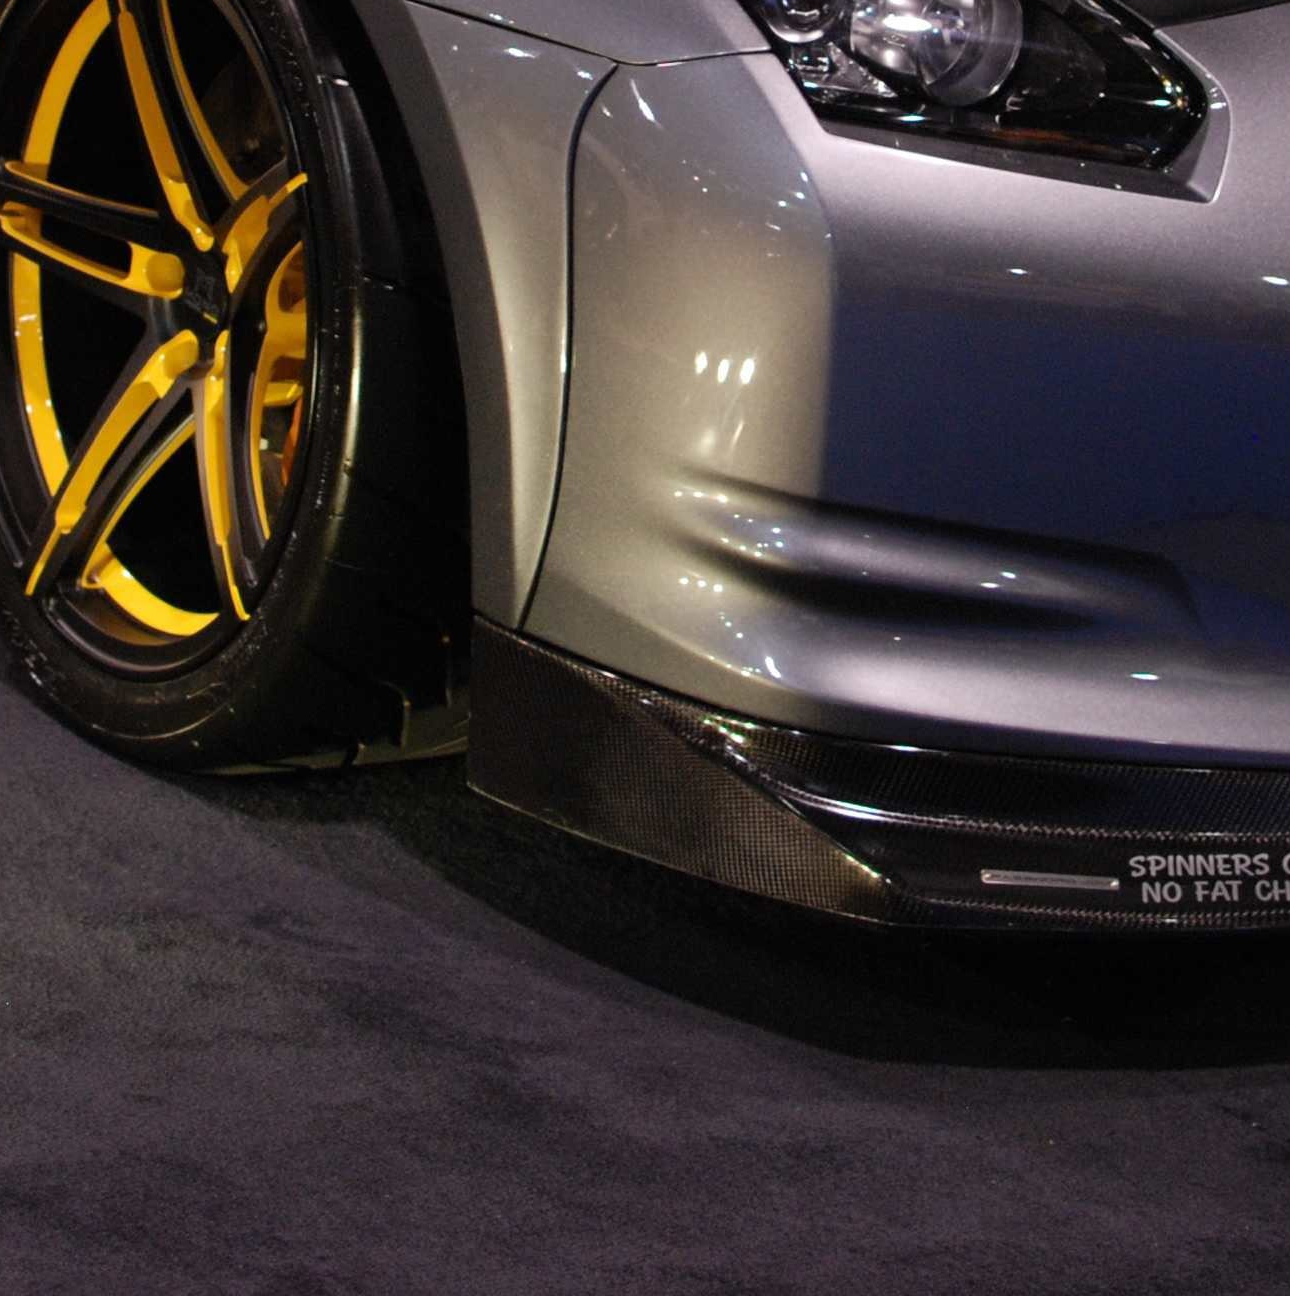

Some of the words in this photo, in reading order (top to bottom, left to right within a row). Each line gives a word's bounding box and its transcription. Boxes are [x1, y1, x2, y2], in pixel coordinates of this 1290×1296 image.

[1129, 852, 1272, 879] SPINNERS
[1141, 880, 1183, 904] NO
[1194, 880, 1243, 903] FAT
